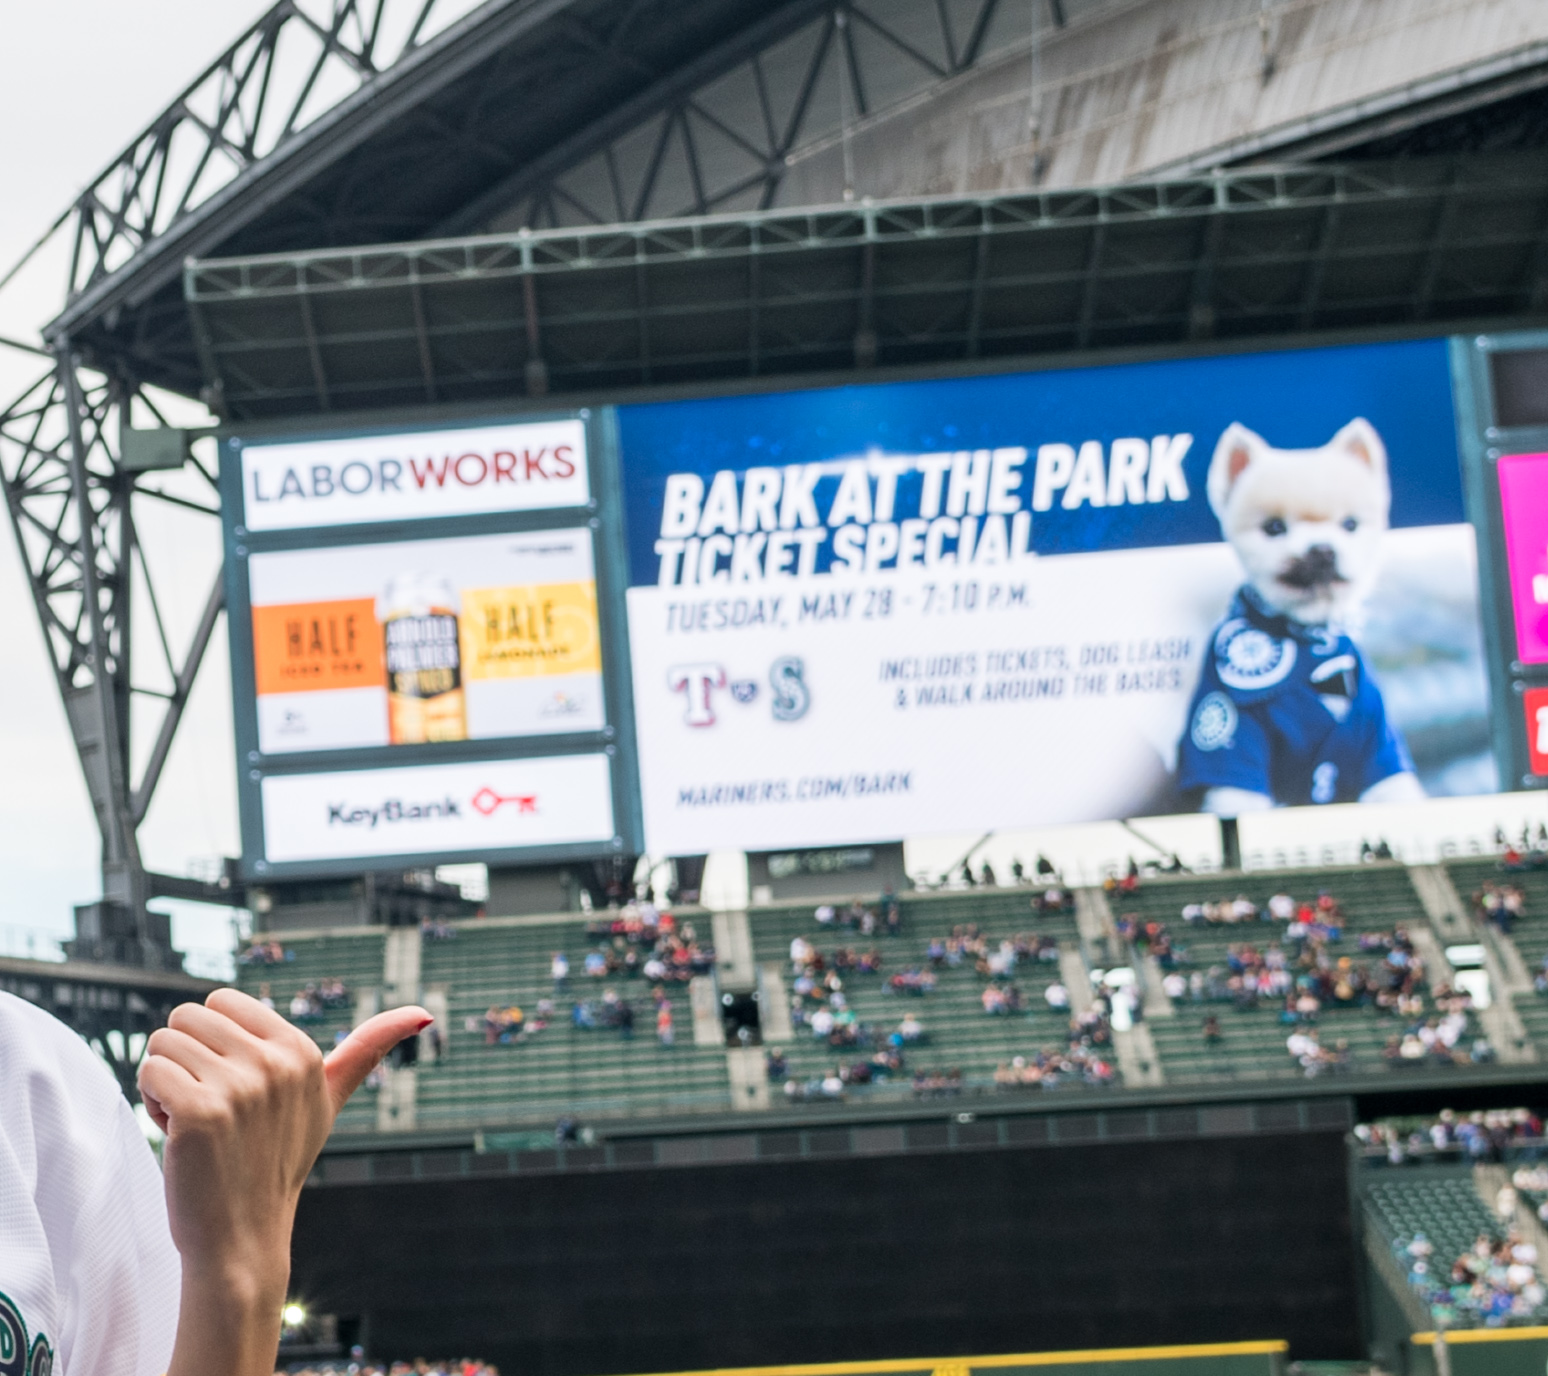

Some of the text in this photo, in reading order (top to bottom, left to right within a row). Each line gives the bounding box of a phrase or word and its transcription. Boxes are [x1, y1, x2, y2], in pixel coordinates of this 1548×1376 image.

[253, 446, 576, 503] LABORWORKS
[660, 433, 1194, 539] BARK AT THE PARK
[654, 511, 1036, 587] TICKET SPECIAL
[484, 601, 556, 642] HALF
[667, 597, 788, 633] TUESDAY,
[798, 591, 855, 622] MAY
[862, 589, 892, 618] 28
[922, 583, 977, 614] 7:10
[284, 614, 359, 656] HALF
[879, 657, 977, 682] INCLUDES
[913, 683, 974, 707] WALK
[982, 677, 1064, 702] AROUND
[328, 796, 461, 827] KeyBank
